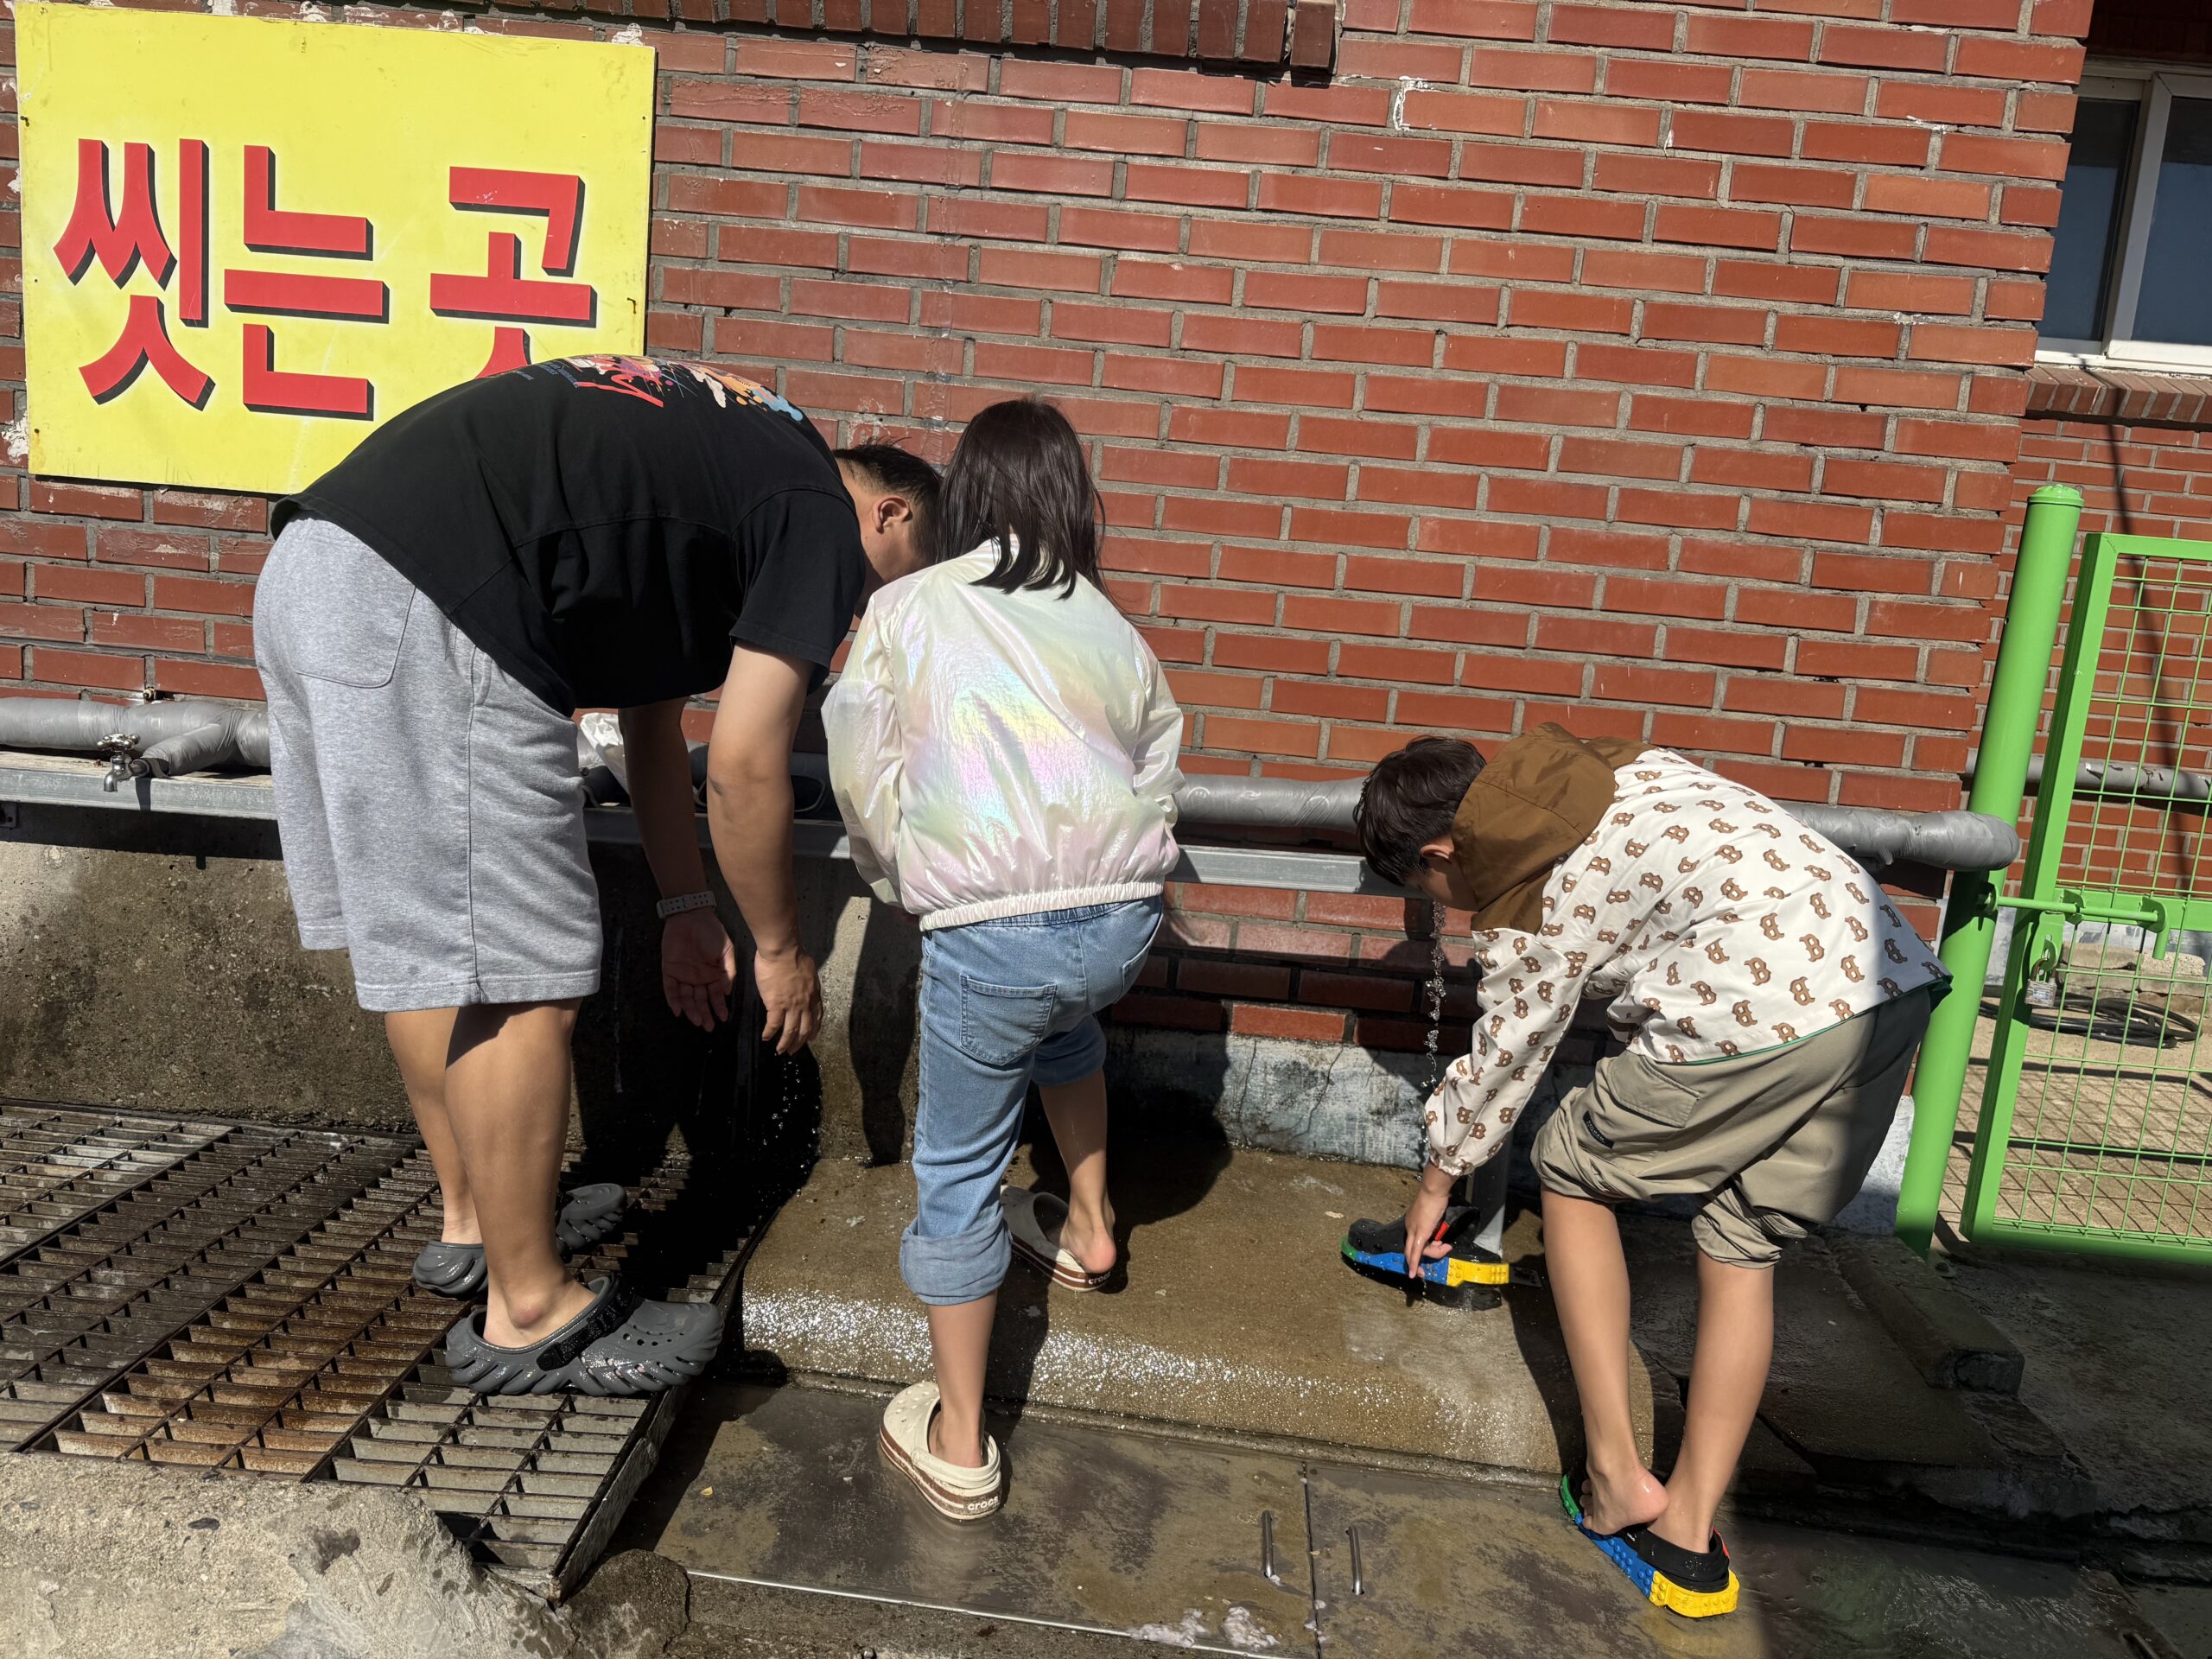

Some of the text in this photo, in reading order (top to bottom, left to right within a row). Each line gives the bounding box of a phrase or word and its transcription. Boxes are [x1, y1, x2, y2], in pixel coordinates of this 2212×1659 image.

[53, 138, 597, 421] 씻는 곳
[967, 1496, 999, 1511] crocs
